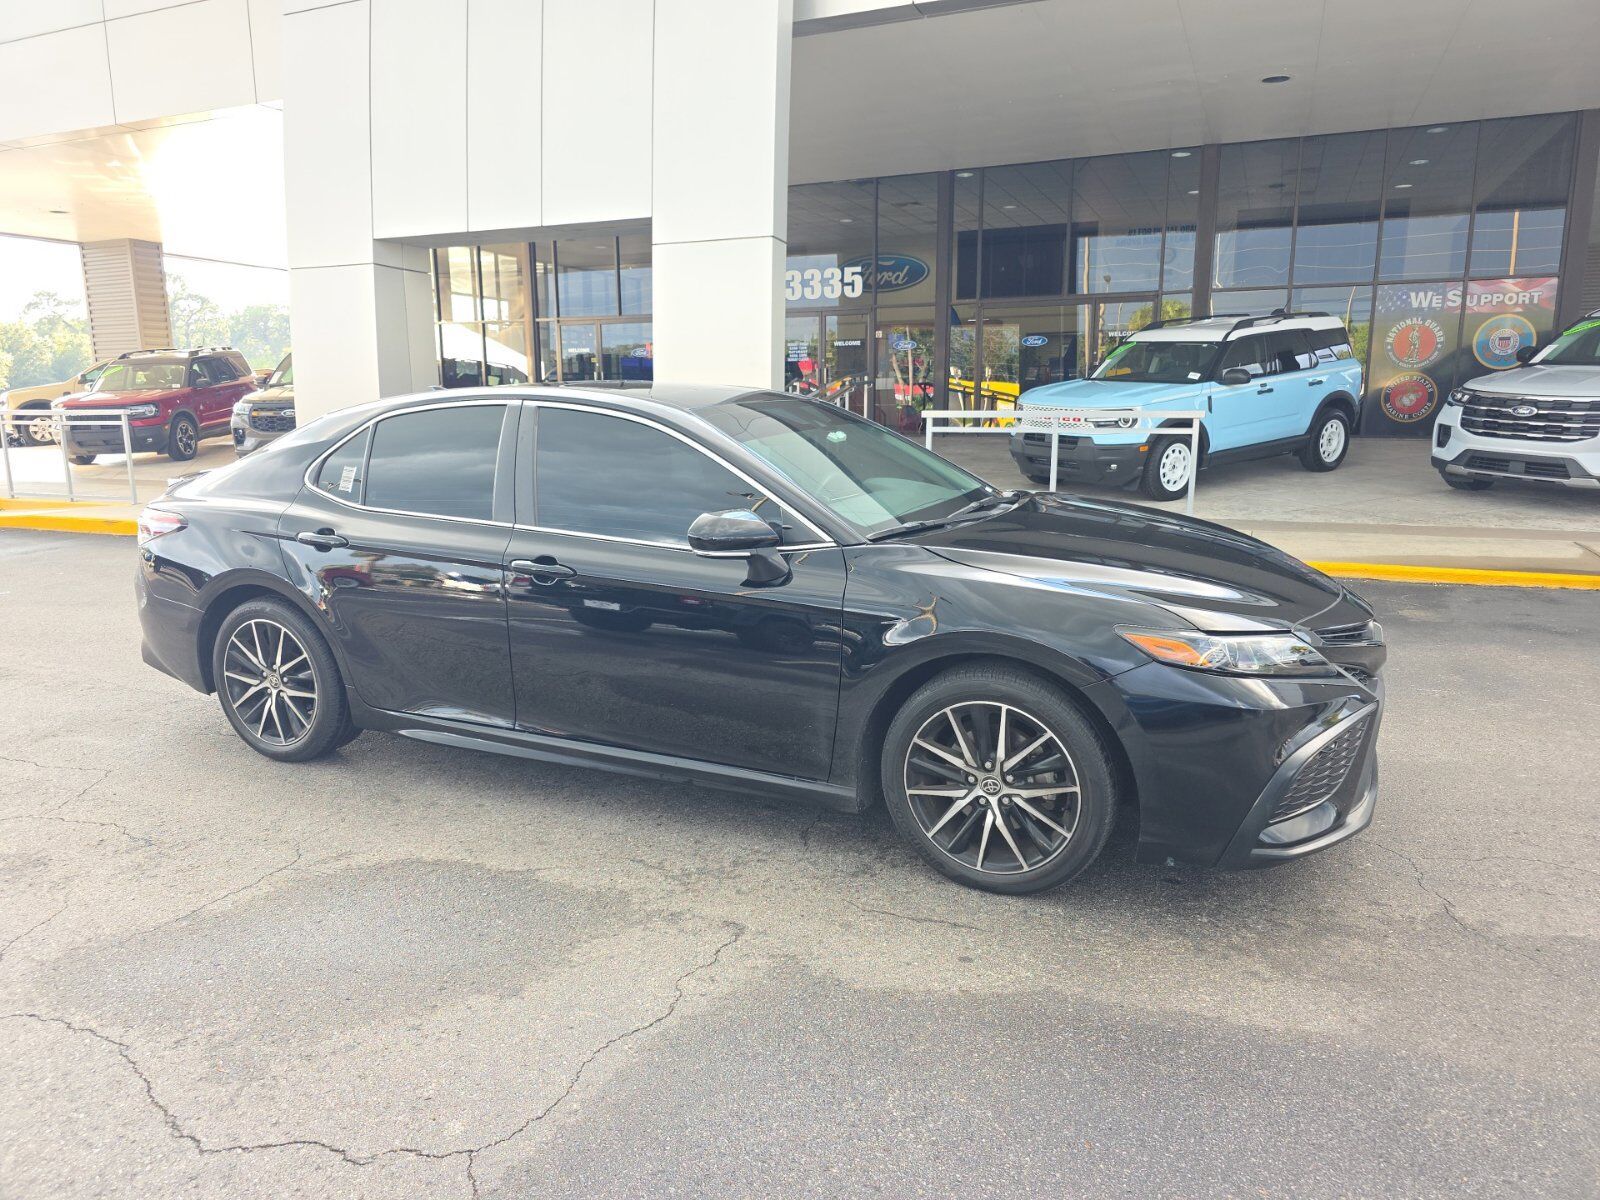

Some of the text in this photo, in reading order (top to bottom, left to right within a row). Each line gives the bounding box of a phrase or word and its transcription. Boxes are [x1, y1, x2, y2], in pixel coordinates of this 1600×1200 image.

[785, 265, 864, 301] 3335
[1108, 330, 1137, 338] WELCO
[1385, 317, 1444, 343] NATIONAL GUARD
[1386, 375, 1434, 393] UNITED STATES
[1385, 402, 1432, 419] MARINE CORPS
